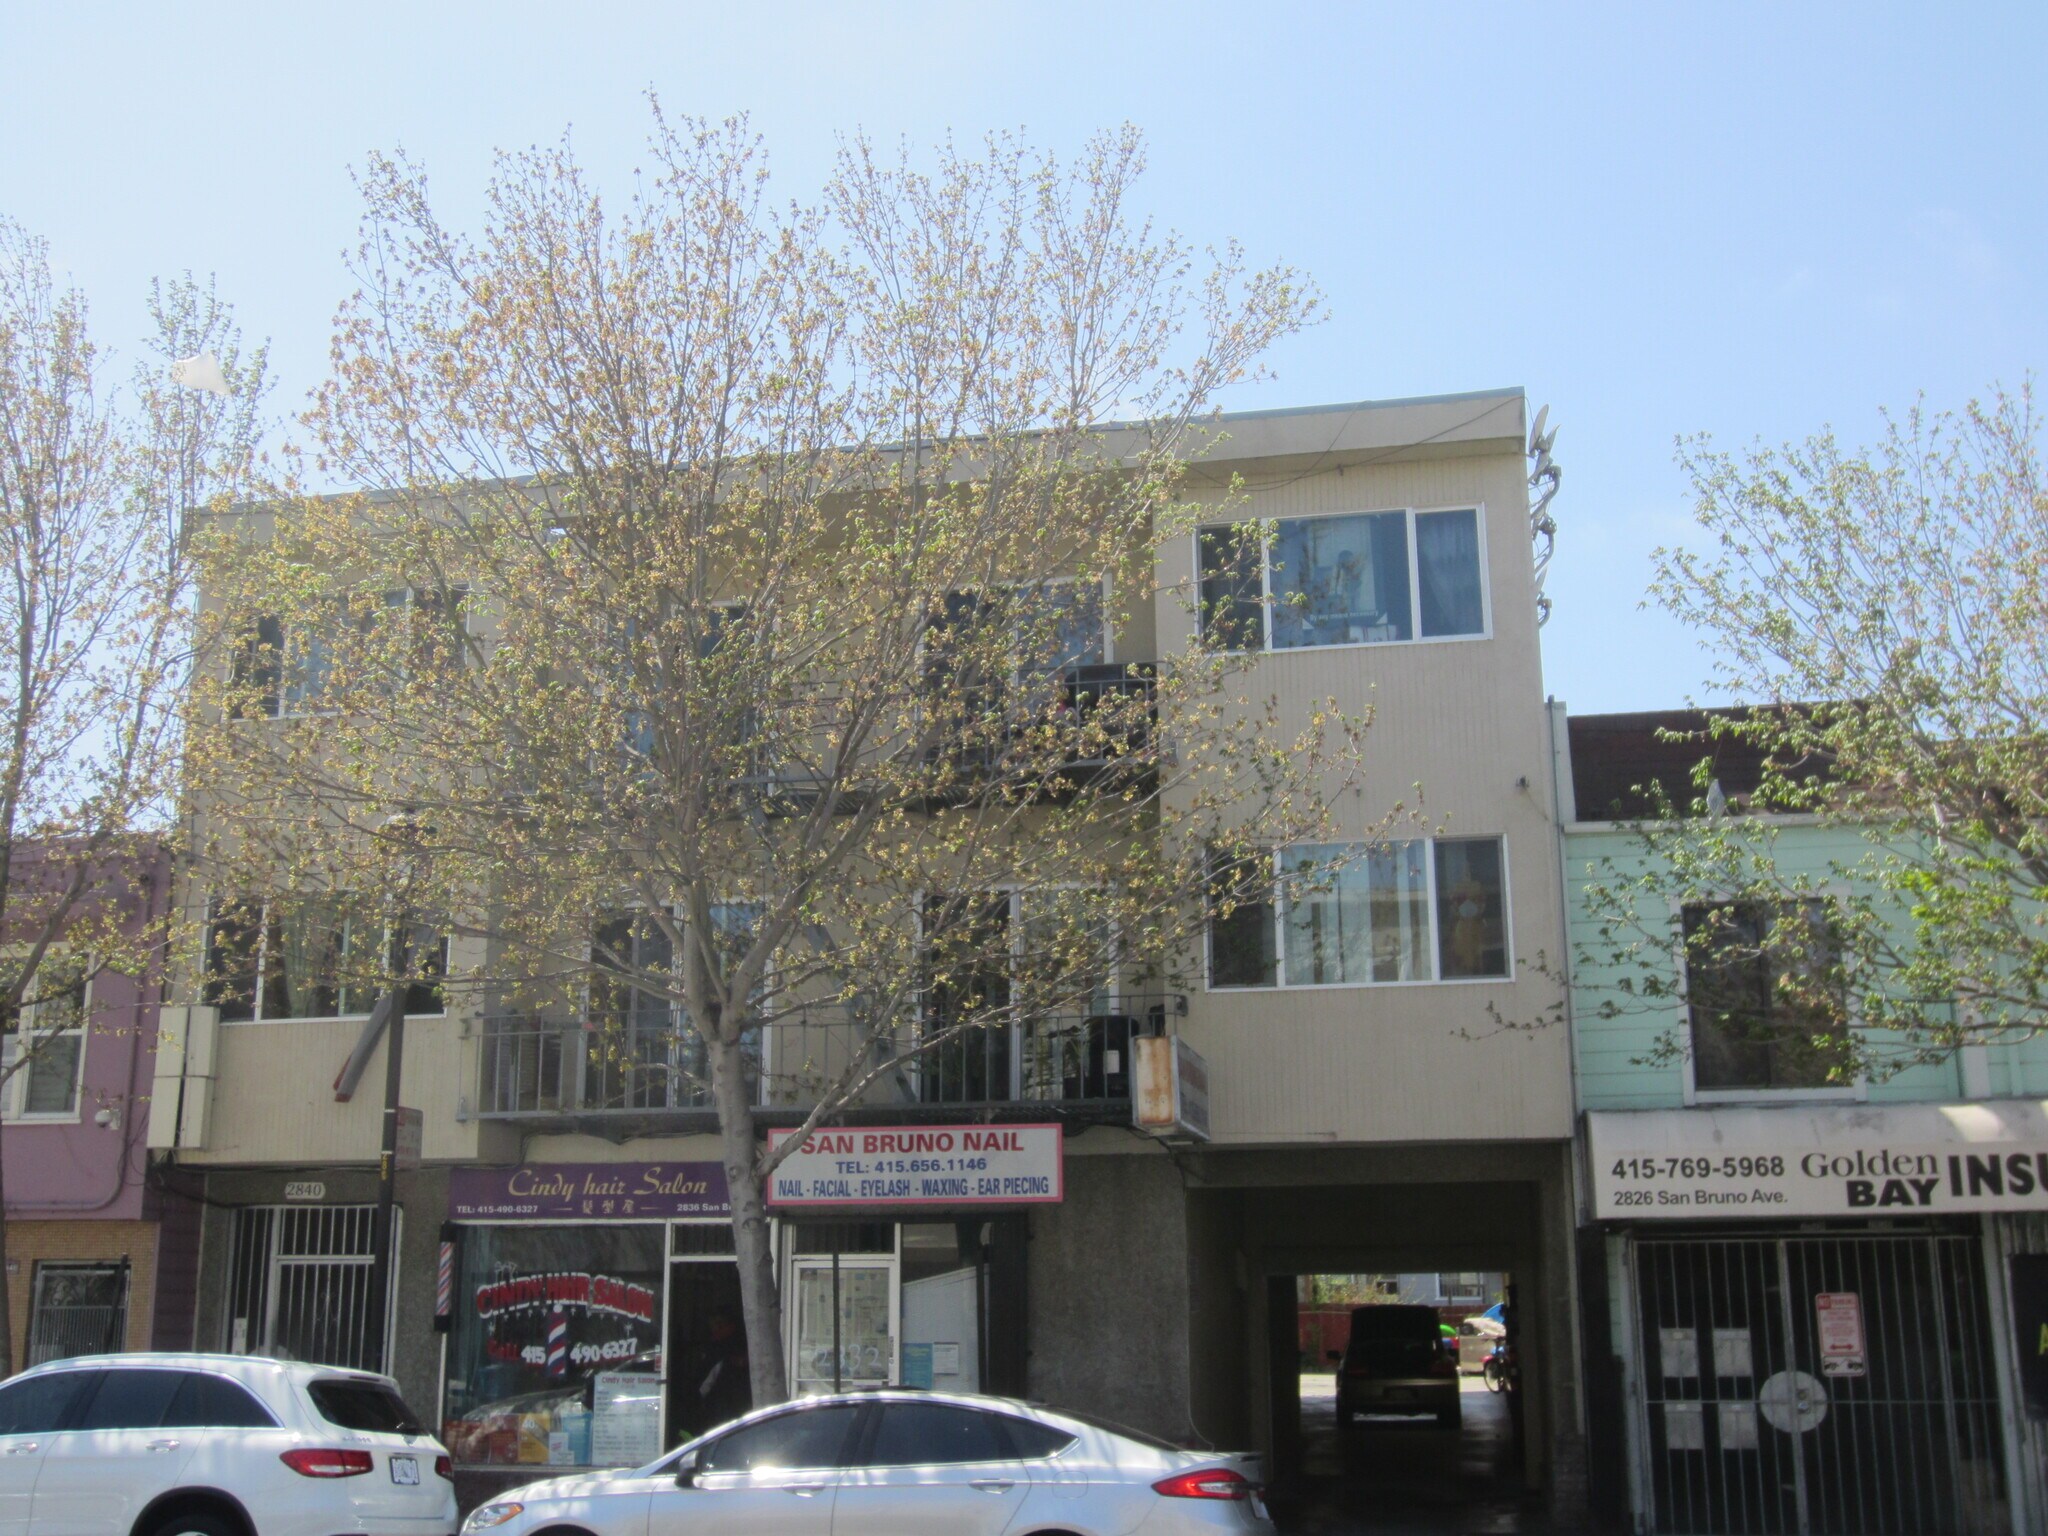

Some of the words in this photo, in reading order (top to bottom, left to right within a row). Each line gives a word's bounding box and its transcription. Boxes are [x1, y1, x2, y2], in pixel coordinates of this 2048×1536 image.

[800, 1135, 854, 1155] SAN
[863, 1132, 954, 1154] BRUNO
[963, 1132, 1024, 1152] NAIL
[836, 1161, 870, 1174] TEL:
[875, 1158, 987, 1173] 415.656.1146
[1611, 1156, 1785, 1179] 415-769-5968
[1801, 1149, 1938, 1179] Golden
[287, 1183, 322, 1197] 2840
[508, 1169, 575, 1202] Cindy
[583, 1172, 626, 1196] hair
[633, 1166, 708, 1196] Salon
[778, 1179, 803, 1197] NAIL
[813, 1179, 851, 1197] FACIAL
[861, 1179, 910, 1197] EYELASH
[922, 1178, 968, 1196] WAXING
[978, 1178, 1000, 1195] EAR
[1004, 1176, 1049, 1195] PIECING
[1846, 1178, 1940, 1207] BAY
[677, 1203, 700, 1212] 2836
[702, 1203, 720, 1212] San
[1614, 1191, 1653, 1206] 2826
[1657, 1190, 1690, 1205] San
[1694, 1189, 1748, 1205] Bruno
[1751, 1188, 1788, 1204] Ave.
[457, 1205, 476, 1214] TEL:
[477, 1204, 538, 1214] 415-490-6327
[477, 1274, 543, 1319] CINDY
[592, 1274, 654, 1324] SALON
[520, 1344, 546, 1364] 415
